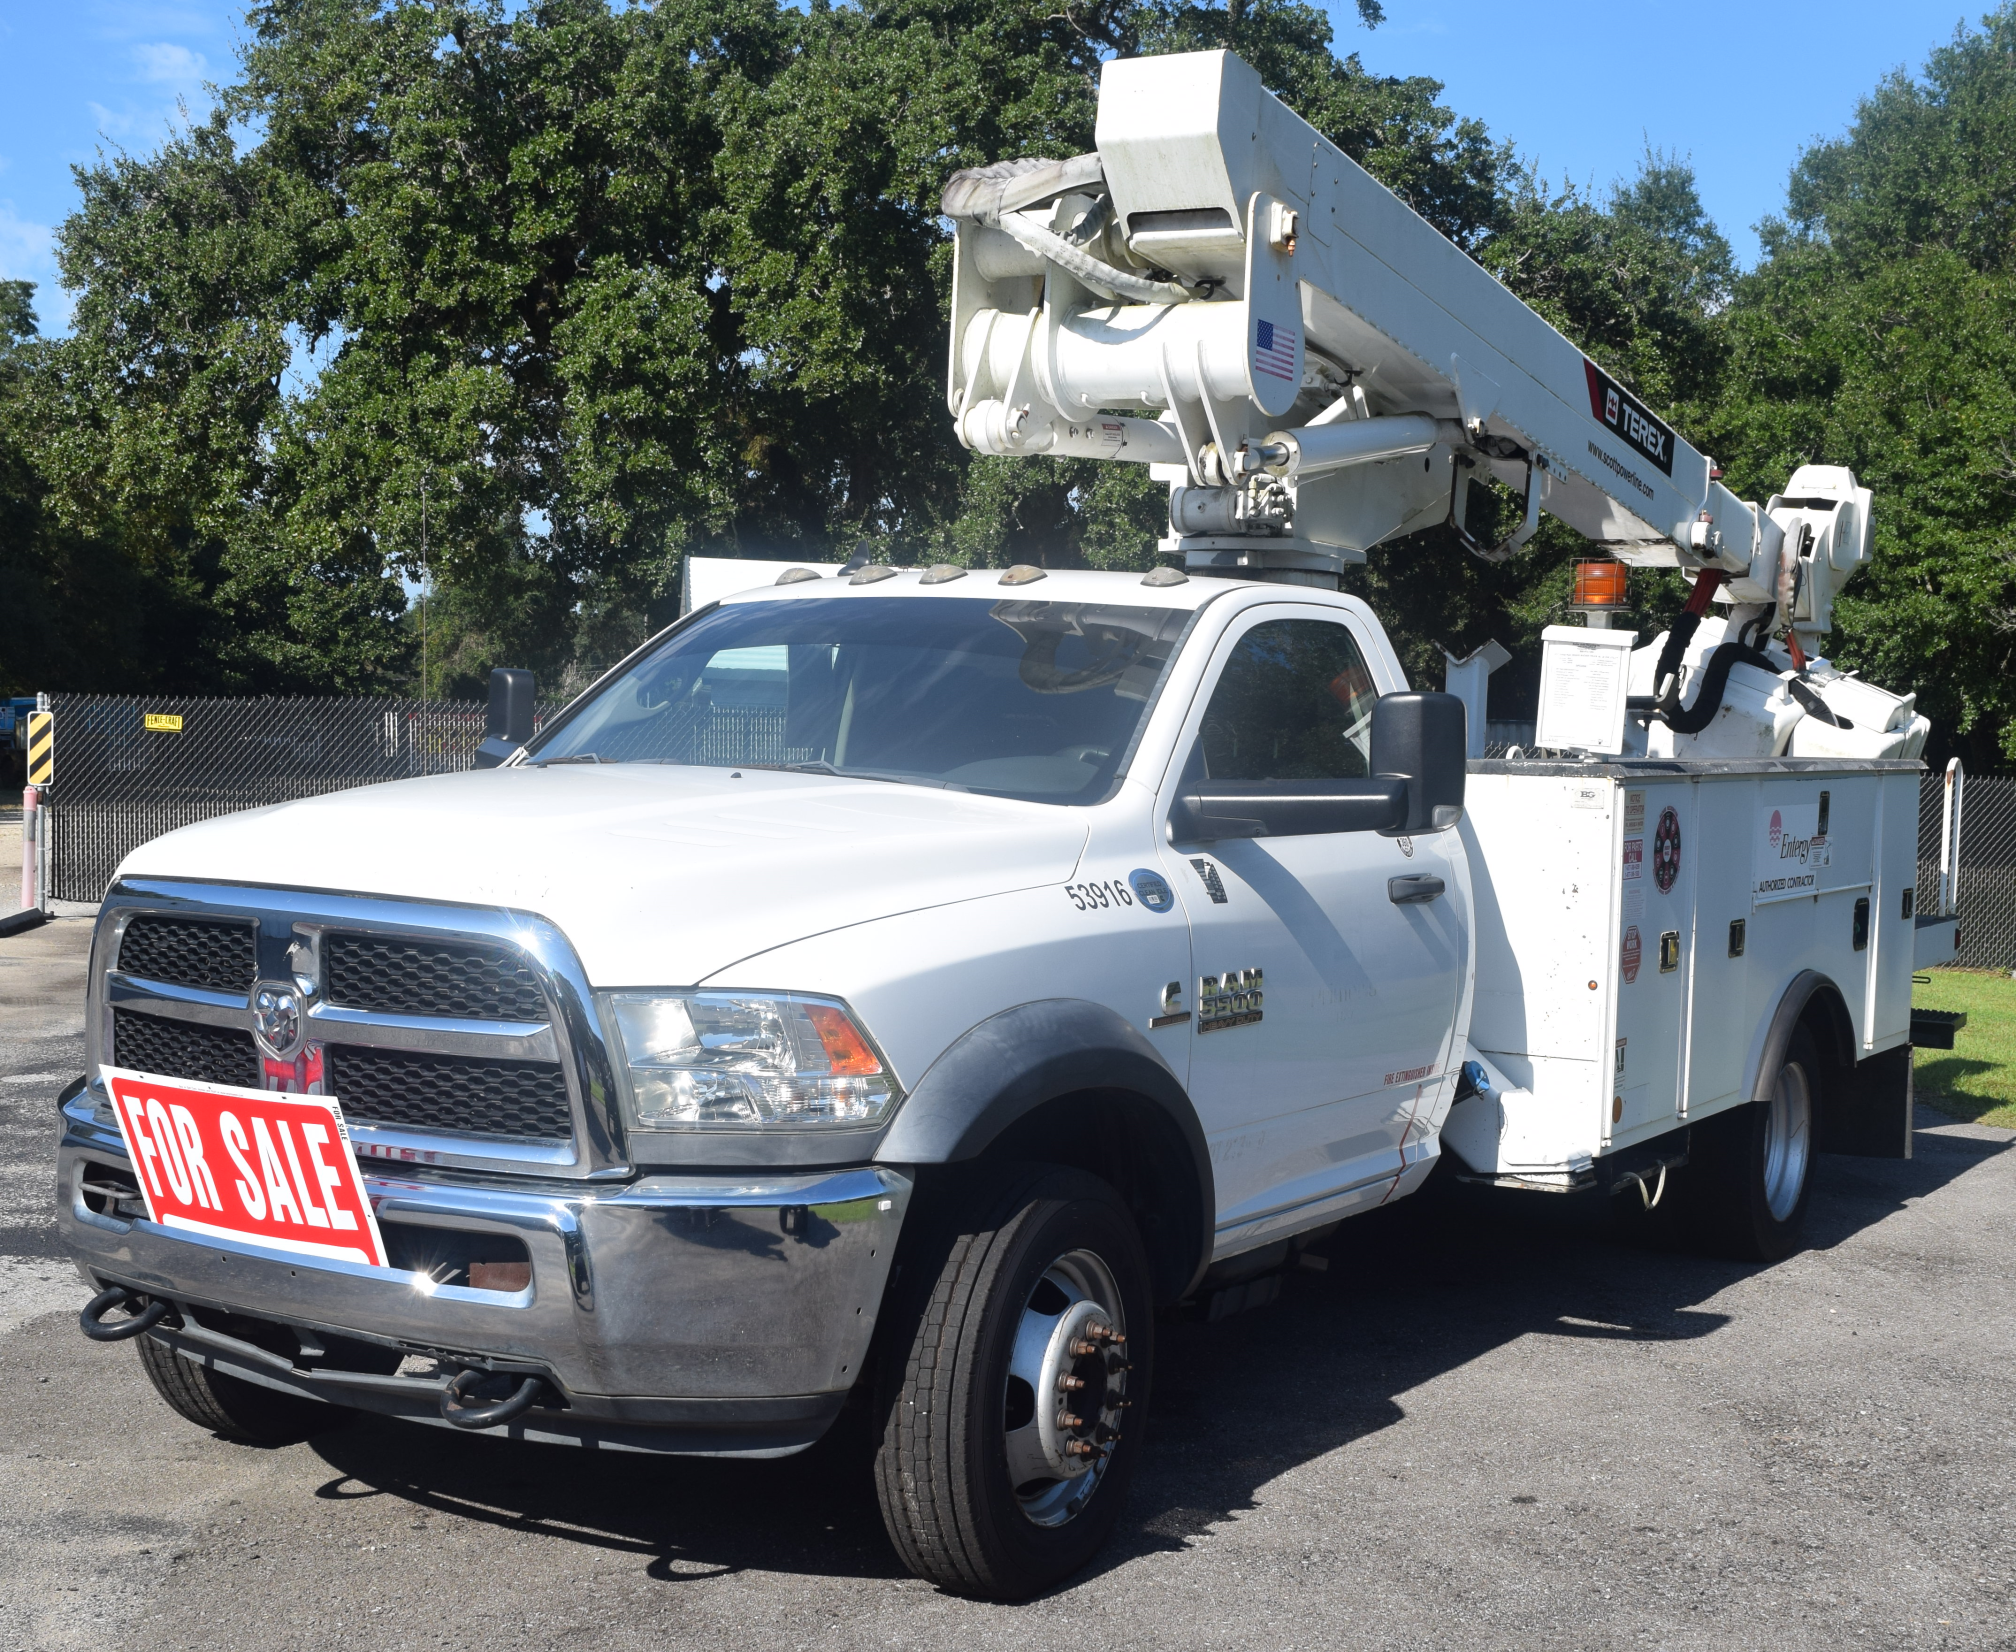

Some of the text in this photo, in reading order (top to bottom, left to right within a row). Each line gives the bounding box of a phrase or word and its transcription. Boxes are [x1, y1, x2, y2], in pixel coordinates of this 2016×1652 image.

[1622, 402, 1666, 461] TEREX
[1587, 439, 1655, 501] www.scottpowerline.com
[1780, 833, 1811, 865] Entergy
[1064, 879, 1133, 911] 53916
[1137, 881, 1162, 889] CERTIFIED
[1139, 889, 1156, 897] CLEAN
[1759, 874, 1815, 893] AUTHORIZED CONTRACTOR
[1199, 968, 1263, 998] RAM
[1199, 988, 1263, 1019] 5500
[1204, 1012, 1261, 1032] HEAVY DUTY
[332, 1106, 348, 1141] FOR SALE
[122, 1095, 359, 1231] FOR SALE
